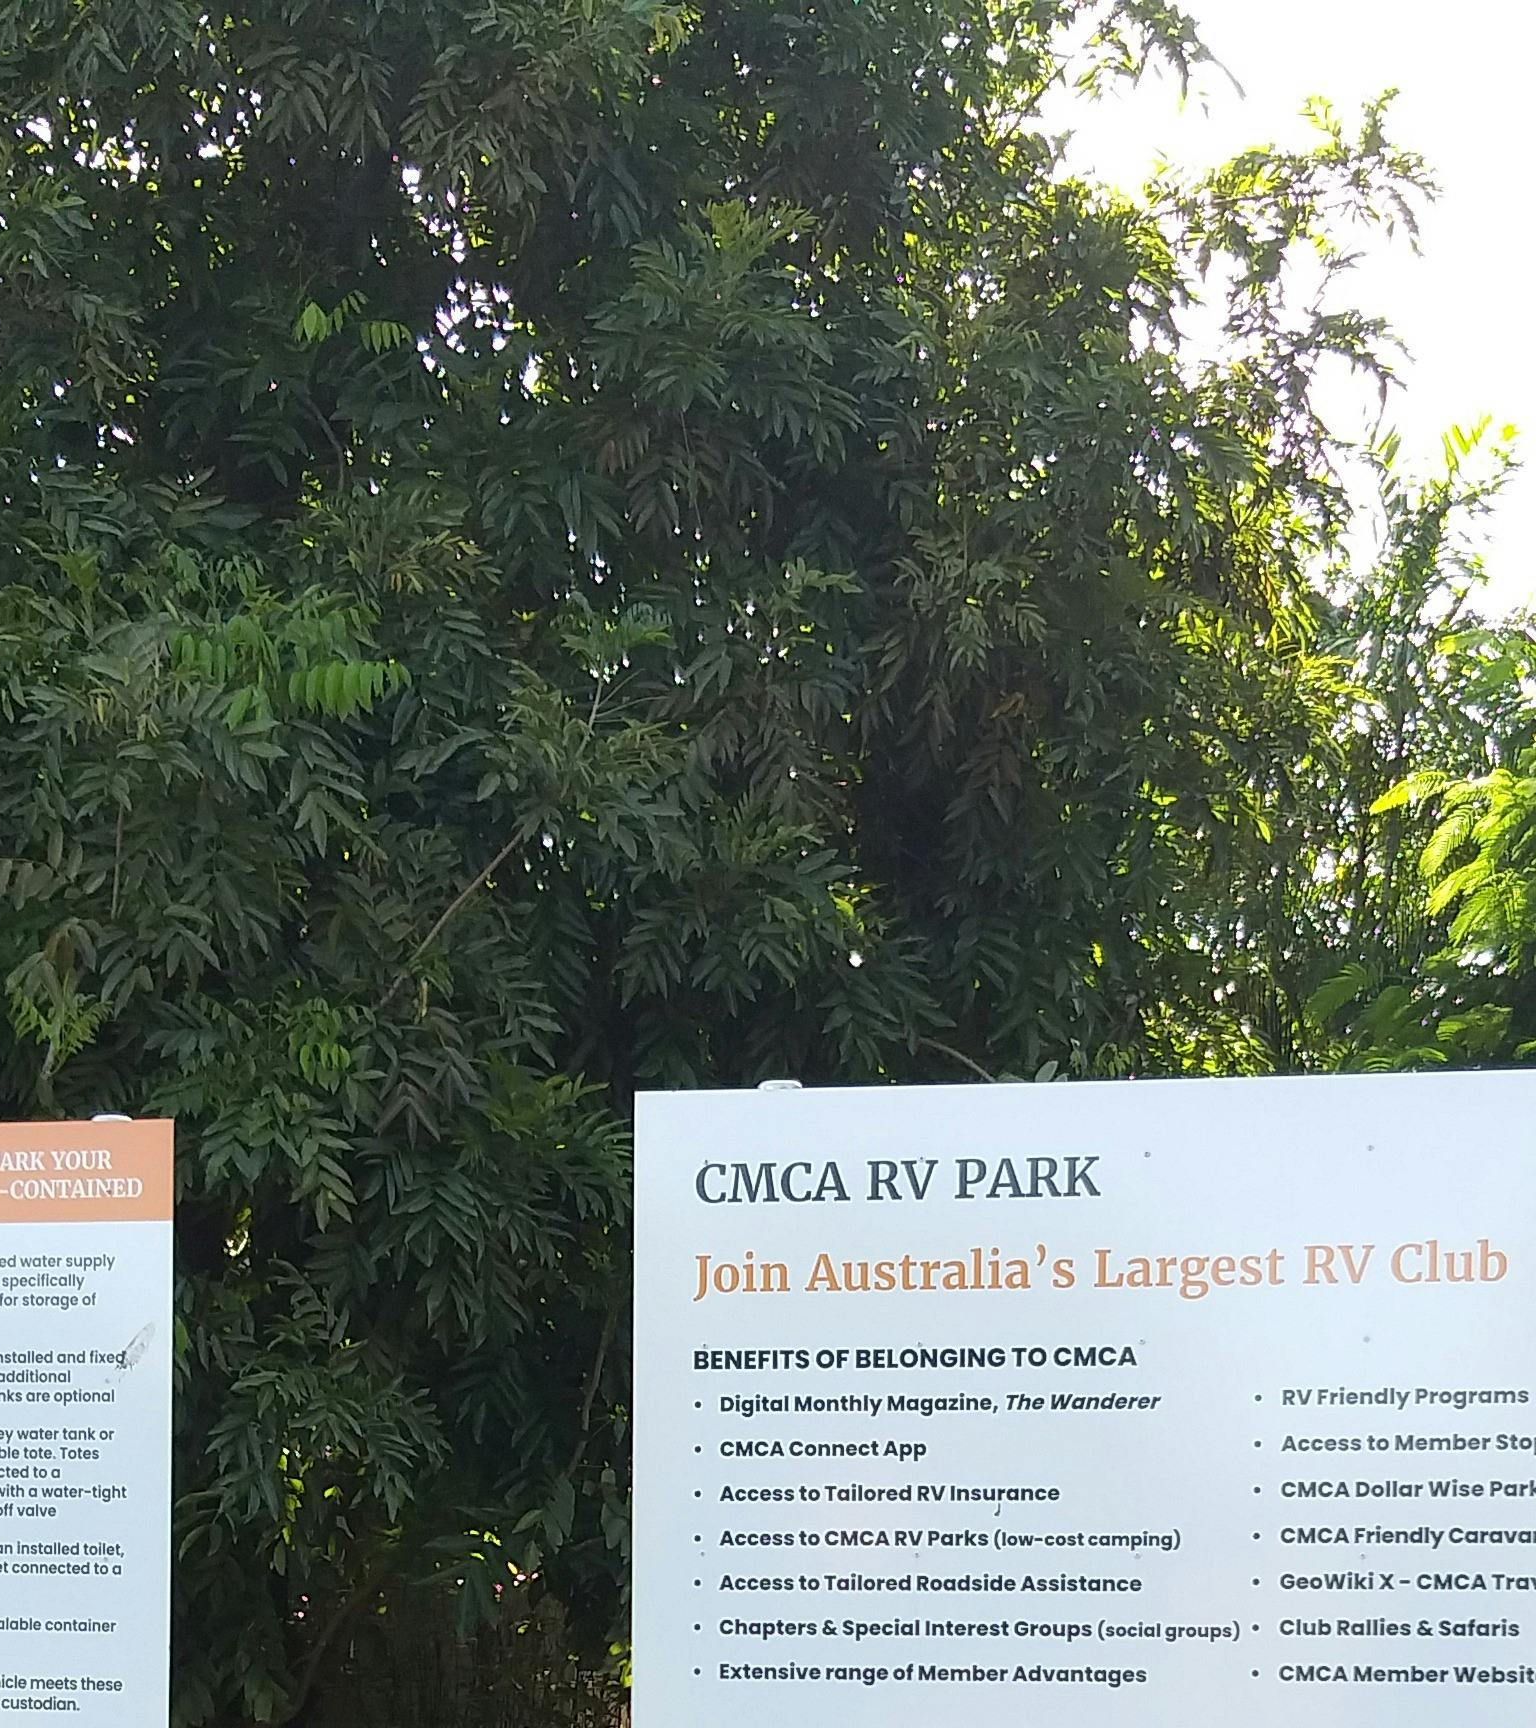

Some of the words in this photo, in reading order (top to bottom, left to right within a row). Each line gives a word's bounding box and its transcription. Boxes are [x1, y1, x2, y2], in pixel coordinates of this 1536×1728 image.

[50, 1150, 112, 1170] YOUR
[695, 1159, 850, 1203] CMCA
[866, 1156, 938, 1200] RV
[954, 1156, 1101, 1199] PARK
[693, 1251, 790, 1301] Join
[804, 1244, 1075, 1291] Australia’s
[1094, 1248, 1284, 1299] Largest
[1305, 1245, 1374, 1283] RV
[1394, 1239, 1507, 1282] Club
[693, 1349, 809, 1369] BENEFITS
[815, 1349, 849, 1368] OF
[855, 1347, 1005, 1368] BELONGING
[1011, 1347, 1047, 1367] TO
[1053, 1346, 1137, 1366] CMCA
[720, 1393, 789, 1417] Digital
[794, 1394, 882, 1416] Monthly
[887, 1392, 998, 1416] Magazine,
[1006, 1393, 1044, 1410] The
[1050, 1392, 1161, 1410] Wanderer
[1282, 1388, 1312, 1405] RV
[1317, 1386, 1410, 1410] Friendly
[1415, 1388, 1528, 1409] Programs
[720, 1440, 784, 1456] CMCA
[788, 1440, 878, 1456] Connect
[883, 1440, 926, 1461] App
[1281, 1435, 1361, 1451] Access
[1366, 1435, 1389, 1451] to
[1394, 1433, 1491, 1451] Member
[719, 1485, 794, 1501] Access
[798, 1485, 820, 1501] to
[824, 1483, 912, 1501] Tailored
[917, 1485, 945, 1501] RV
[950, 1485, 1060, 1501] Insurance
[1281, 1481, 1350, 1497] CMCA
[1355, 1480, 1423, 1497] Dollar
[1428, 1478, 1484, 1497] Wise
[719, 1530, 794, 1546] Access
[798, 1530, 820, 1546] to
[824, 1530, 890, 1546] CMCA
[894, 1530, 923, 1546] RV
[927, 1529, 988, 1546] Parks
[994, 1528, 1084, 1550] (low-cost
[1087, 1528, 1180, 1551] camping)
[1280, 1527, 1349, 1543] CMCA
[1354, 1525, 1444, 1549] Friendly
[719, 1574, 794, 1590] Access
[798, 1575, 820, 1590] to
[823, 1573, 911, 1591] Tailored
[916, 1573, 1016, 1591] Roadside
[1020, 1573, 1142, 1591] Assistance
[1280, 1571, 1374, 1589] GeoWiki
[1379, 1573, 1394, 1589] X
[1416, 1573, 1487, 1590] CMCA
[44, 1618, 116, 1632] container
[719, 1618, 817, 1640] Chapters
[822, 1619, 838, 1635] &
[842, 1618, 920, 1641] Special
[925, 1620, 1009, 1636] Interest
[1014, 1620, 1092, 1642] Groups
[1097, 1619, 1160, 1641] (social
[1165, 1620, 1239, 1642] groups)
[1279, 1618, 1331, 1635] Club
[1336, 1617, 1411, 1636] Rallies
[1416, 1619, 1433, 1636] &
[1438, 1618, 1519, 1636] Safaris
[719, 1661, 821, 1680] Extensive
[825, 1667, 888, 1685] range
[892, 1663, 913, 1680] of
[918, 1664, 1008, 1681] Member
[1012, 1665, 1146, 1687] Advantages
[1279, 1665, 1348, 1681] CMCA
[1353, 1665, 1449, 1682] Member
